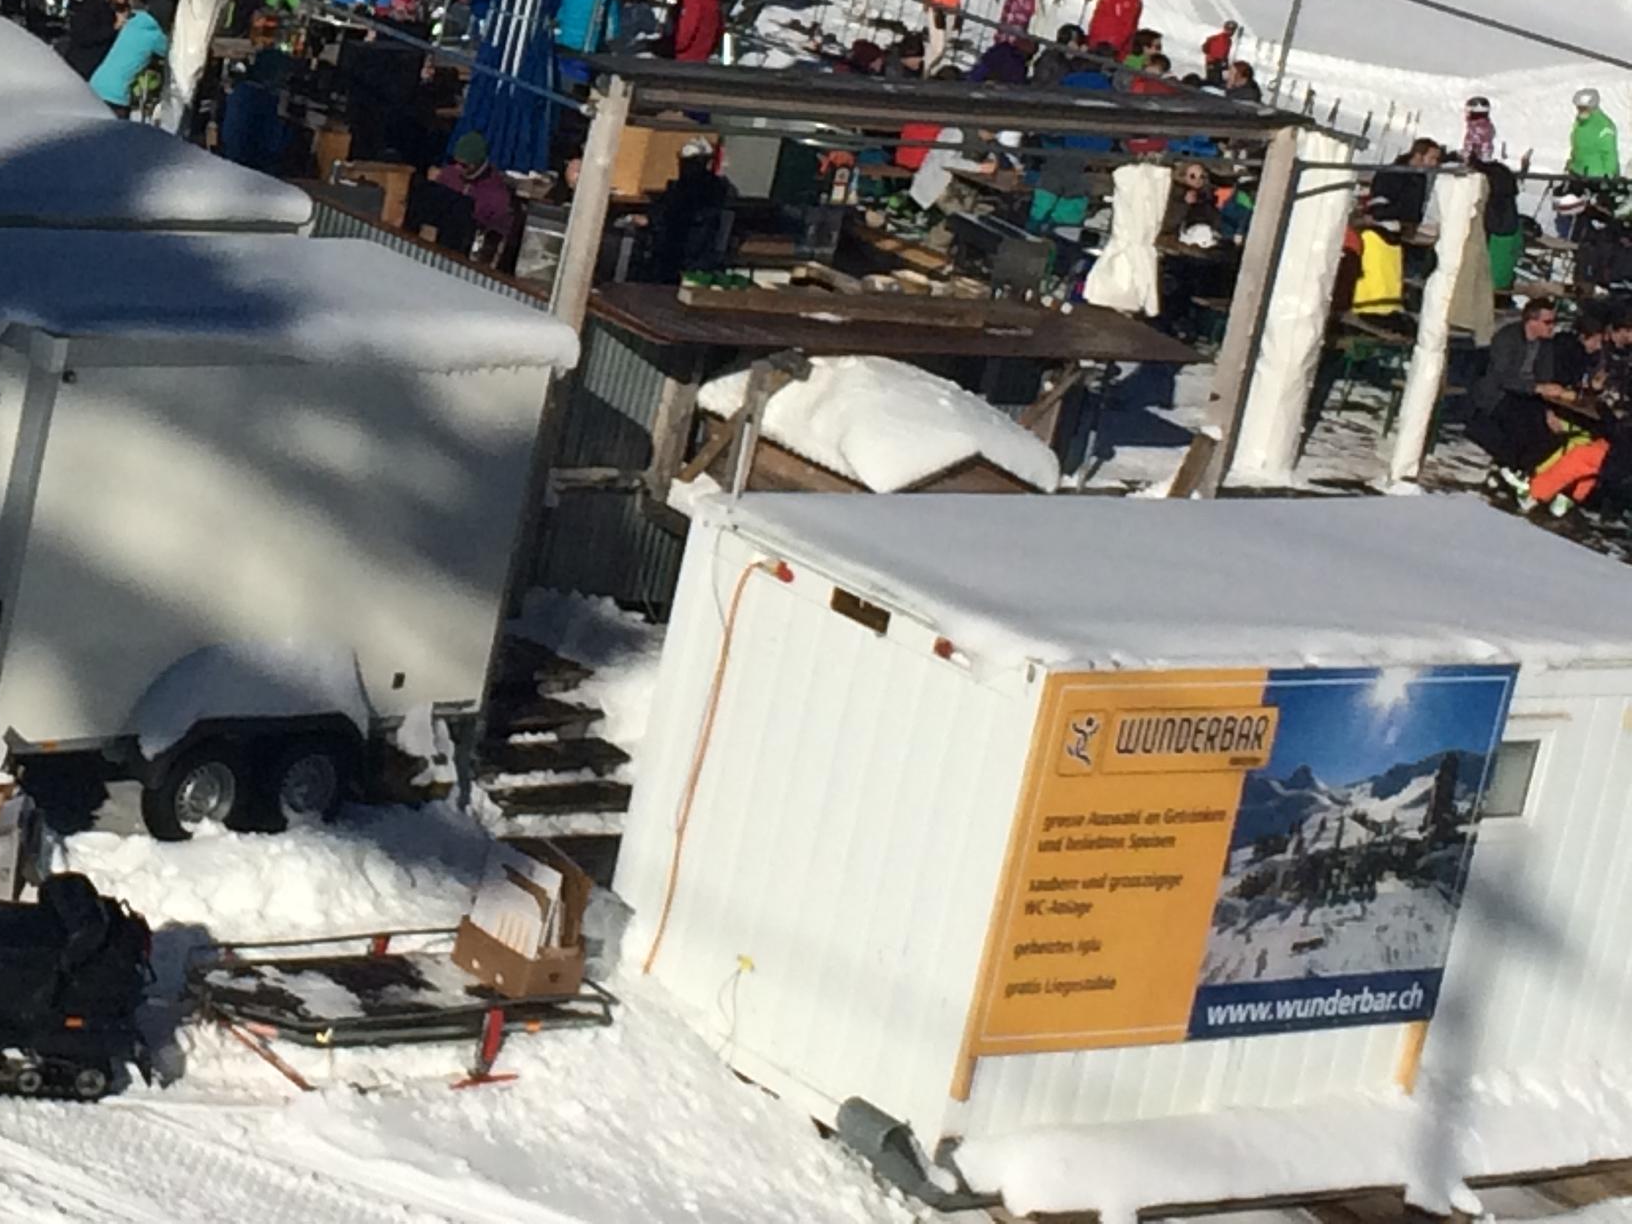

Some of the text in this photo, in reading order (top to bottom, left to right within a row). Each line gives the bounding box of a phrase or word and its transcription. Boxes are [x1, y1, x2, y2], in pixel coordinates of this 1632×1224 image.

[1116, 715, 1270, 754] WUNDERBAR
[1038, 837, 1063, 852] und
[1082, 874, 1108, 889] und
[1207, 981, 1424, 1026] www.wunderbar.ch
